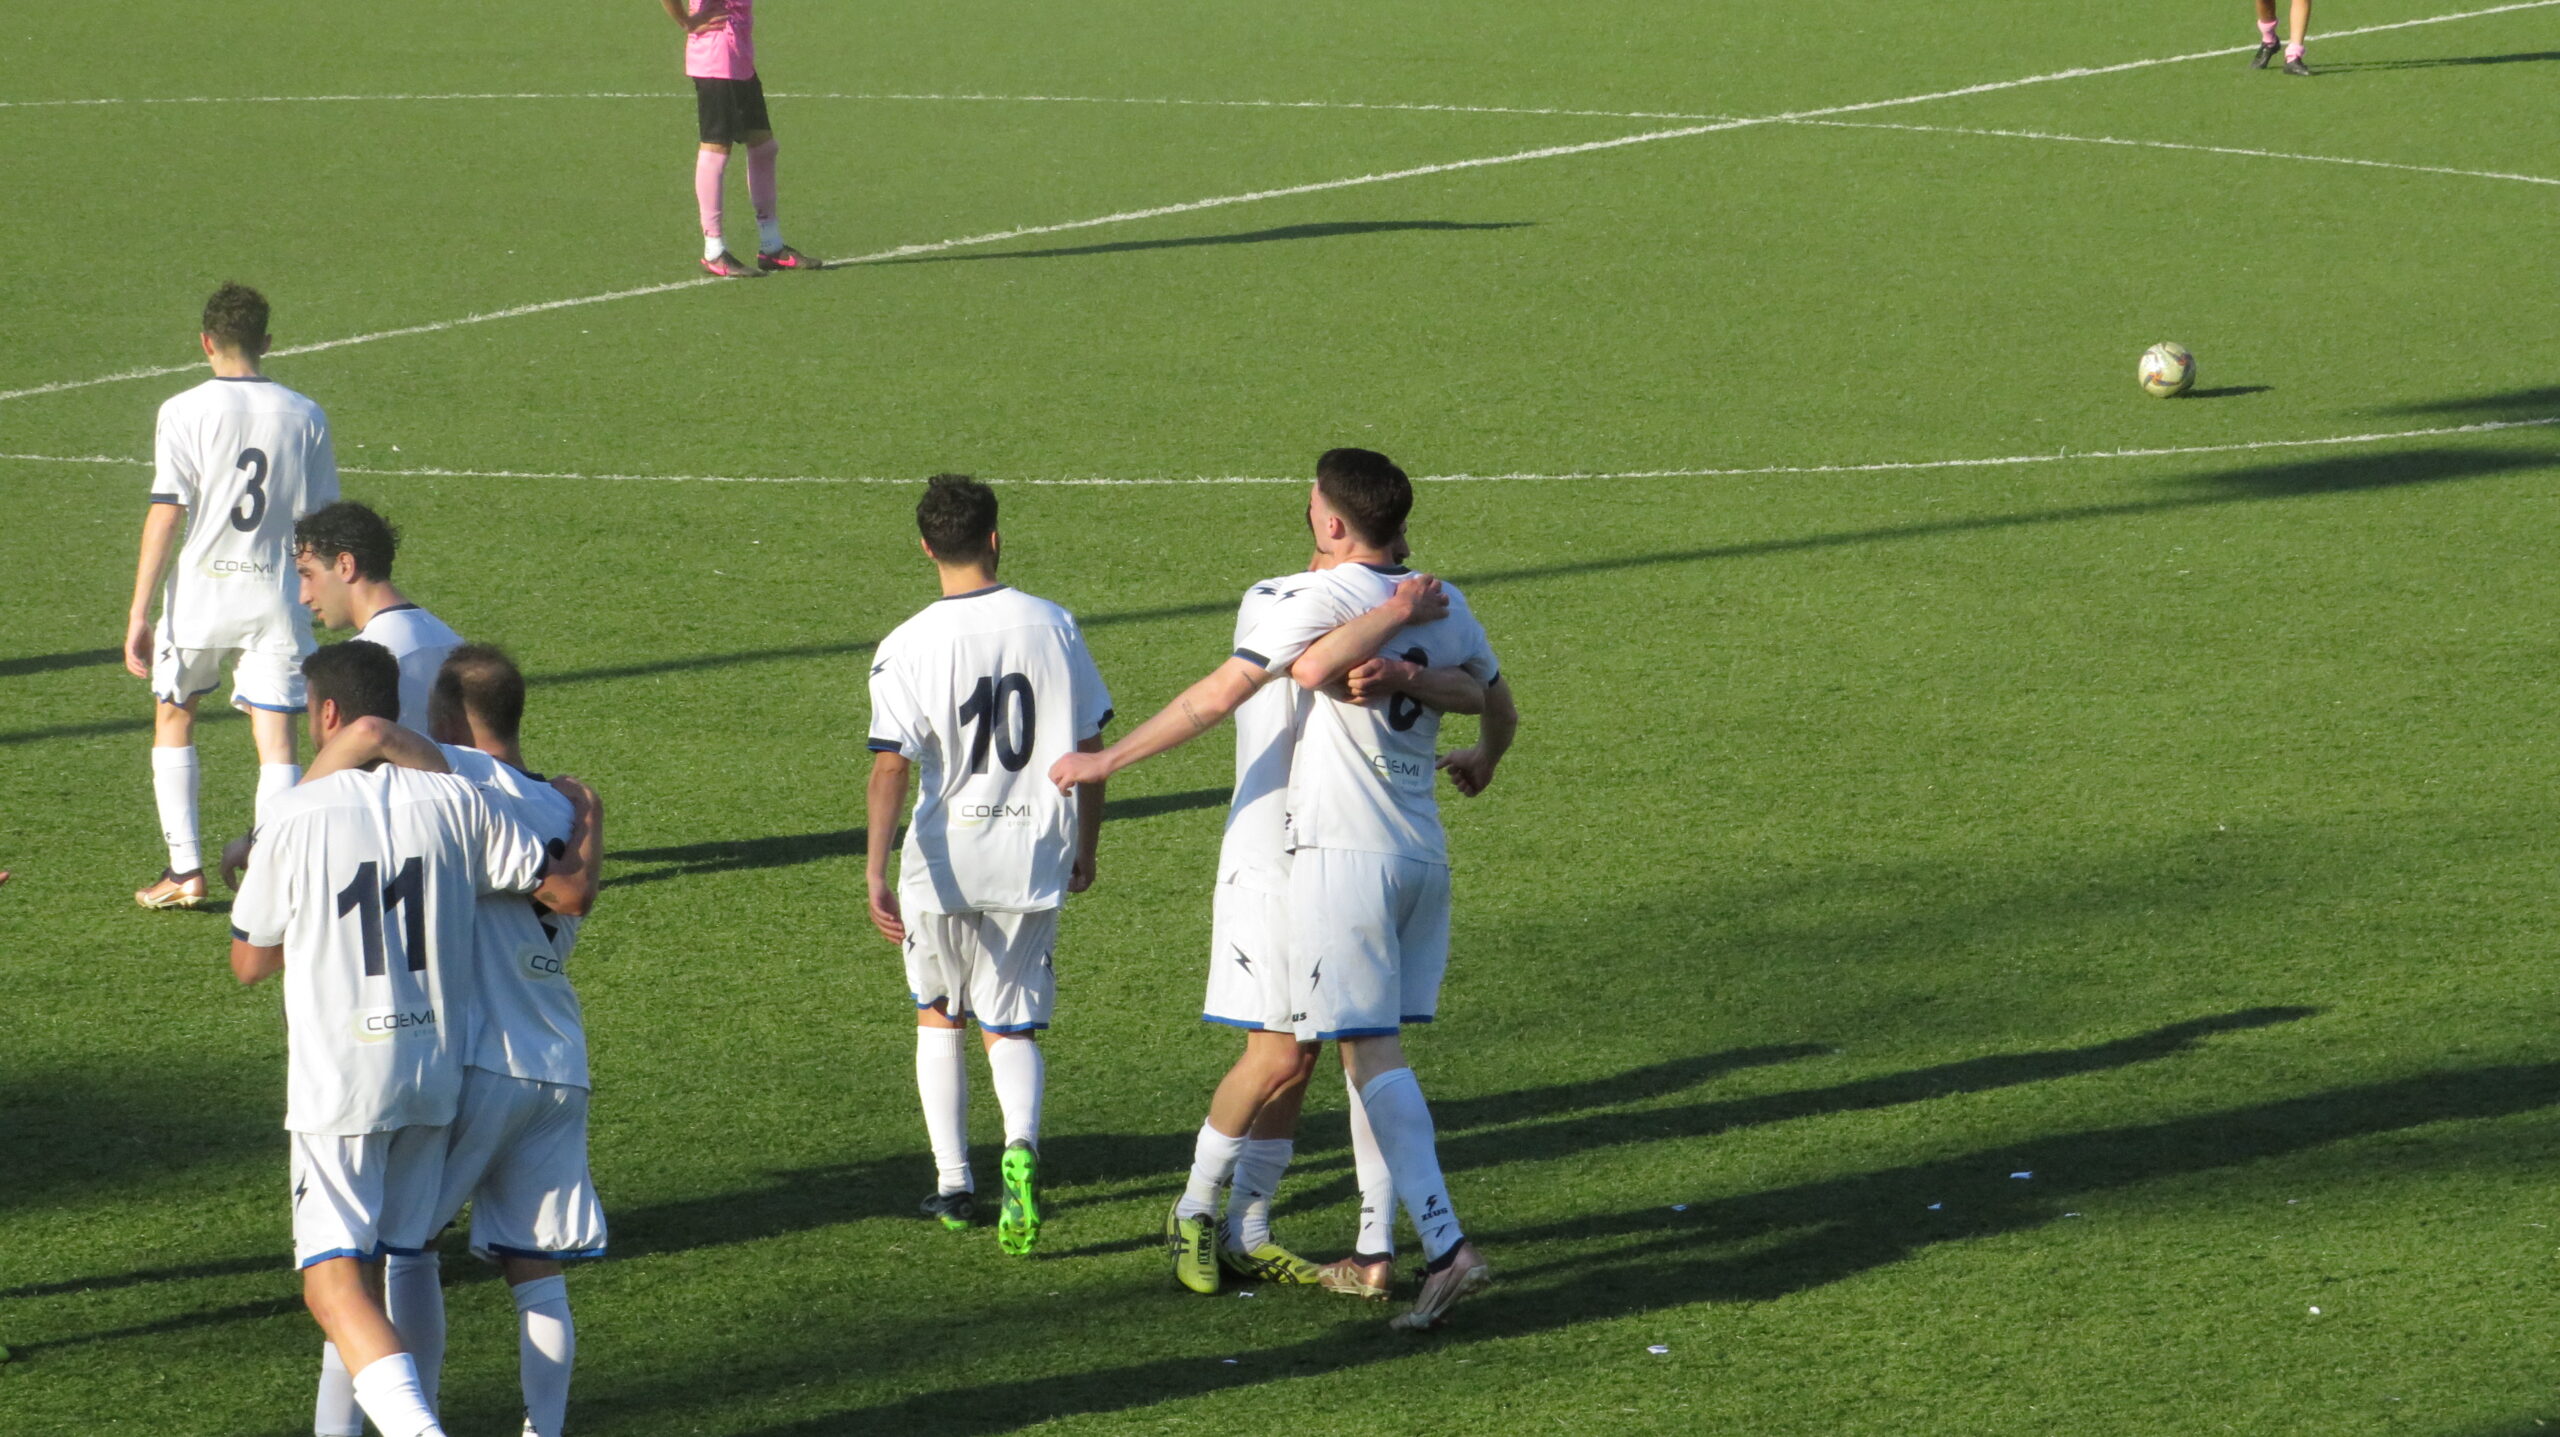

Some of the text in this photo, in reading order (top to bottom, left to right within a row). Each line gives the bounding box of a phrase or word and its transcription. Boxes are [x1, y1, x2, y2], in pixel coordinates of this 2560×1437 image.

[230, 448, 267, 532] 3
[214, 560, 273, 573] COEMI
[959, 672, 1036, 774] 10
[961, 805, 1031, 817] COEMI
[337, 856, 427, 977] 11
[367, 1009, 436, 1031] COEMI
